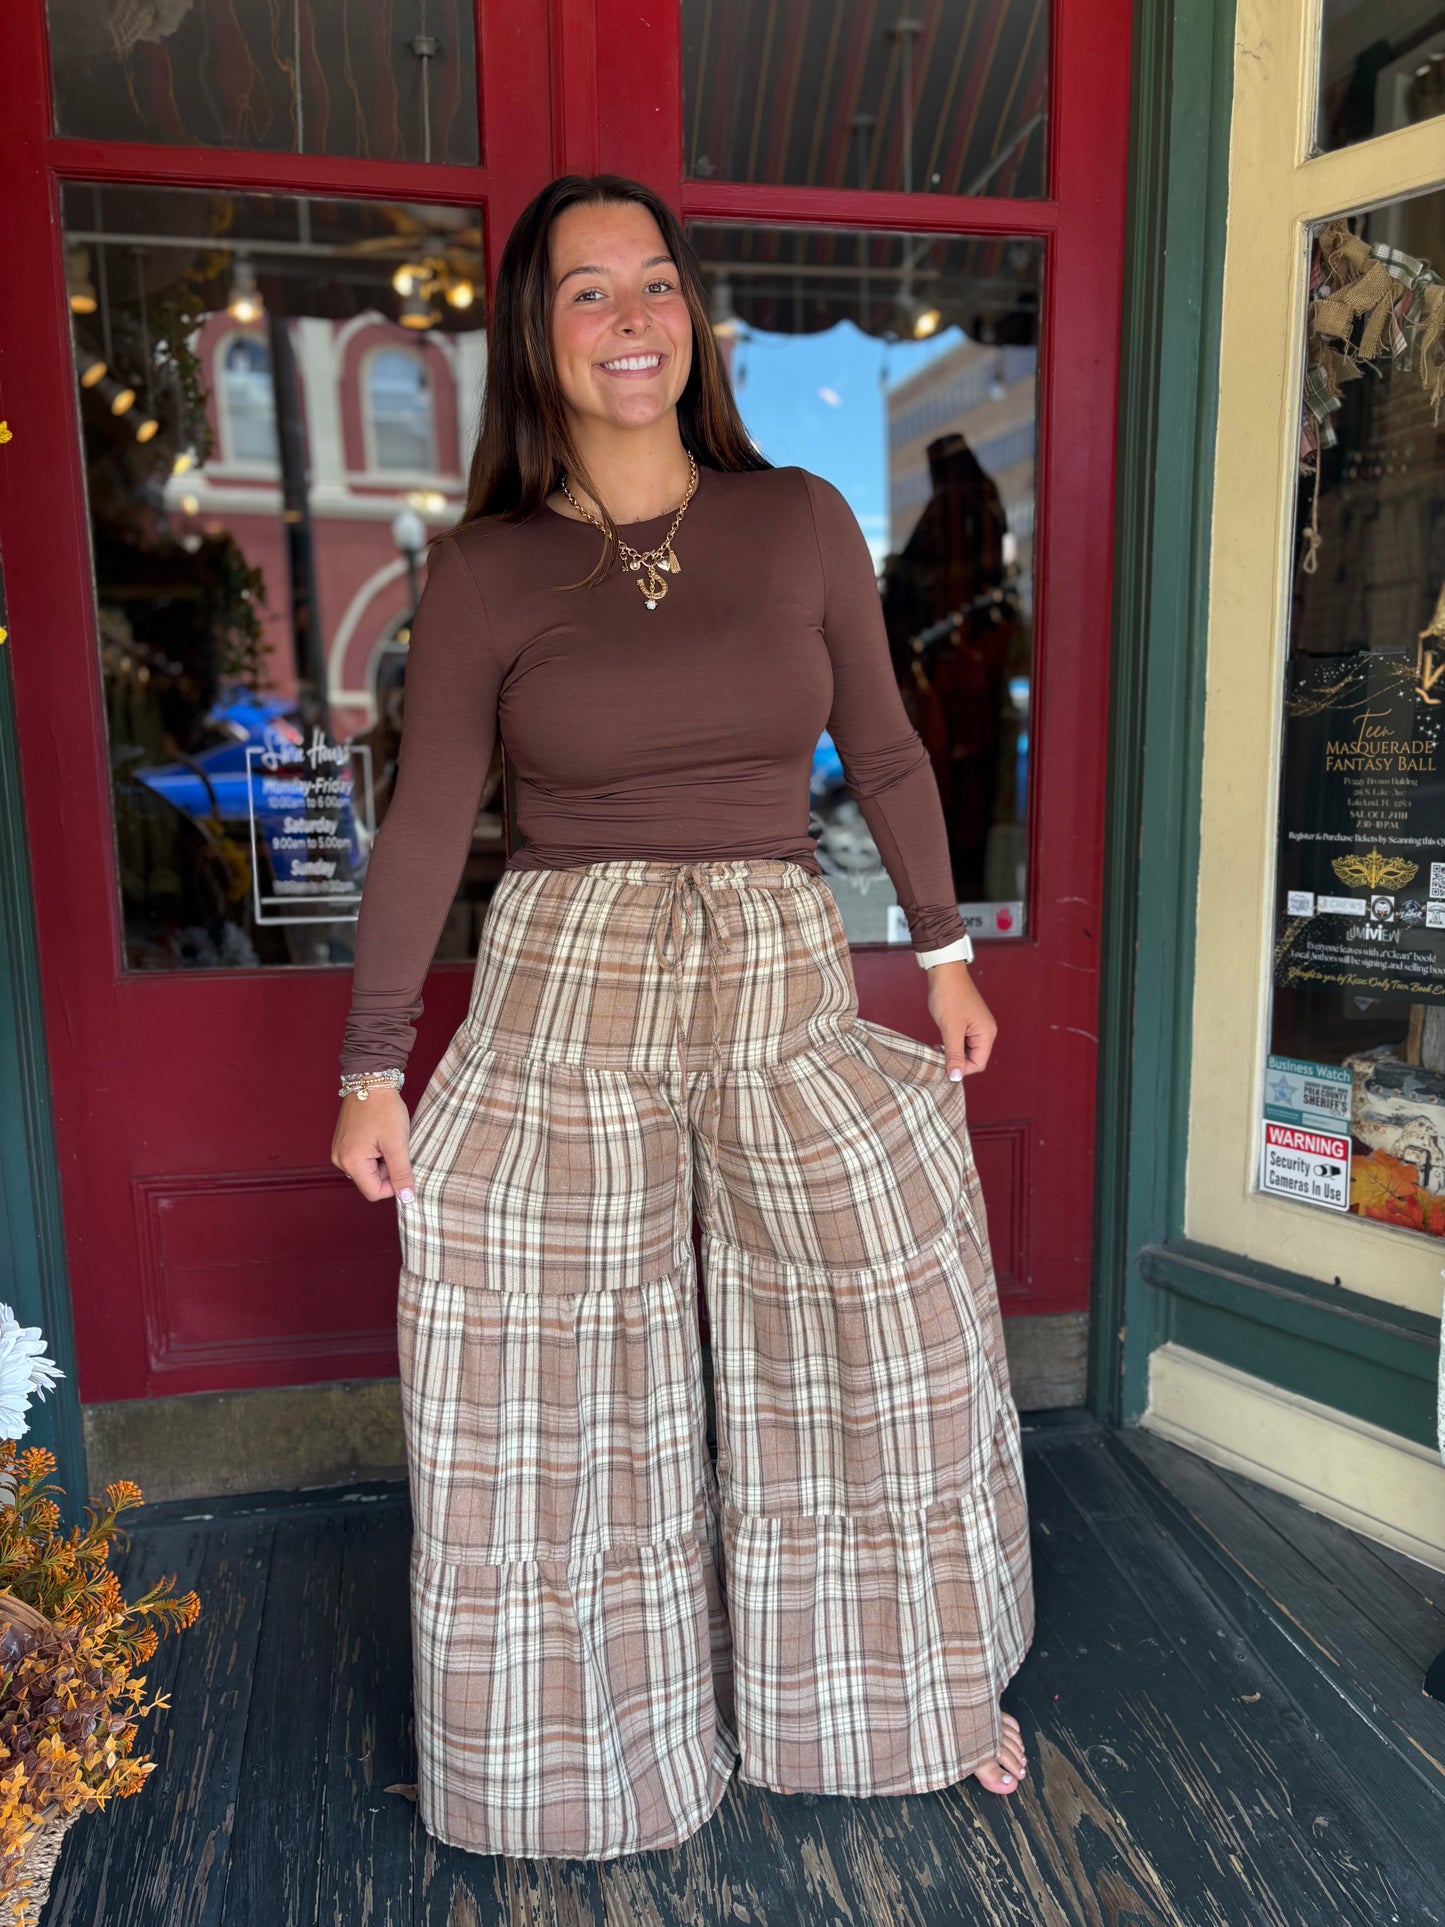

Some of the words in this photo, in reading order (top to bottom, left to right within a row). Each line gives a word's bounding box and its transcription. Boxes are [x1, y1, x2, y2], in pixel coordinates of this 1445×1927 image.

[1352, 708, 1395, 753] Teen
[1326, 740, 1434, 757] MASQUERADE
[1326, 756, 1393, 771] FANTASY
[1398, 756, 1437, 771] BALL
[306, 797, 316, 809] to
[283, 816, 339, 836] Saturday
[306, 838, 317, 849] to
[1288, 831, 1315, 842] Register
[1323, 832, 1353, 842] Purchase
[1354, 834, 1377, 843] Tickets
[1378, 834, 1386, 845] by
[1388, 835, 1421, 847] Scanning
[1422, 836, 1436, 845] this
[290, 858, 337, 878] Sunday
[1363, 947, 1378, 957] with
[1291, 950, 1310, 959] Local
[1351, 956, 1360, 966] be
[1361, 959, 1387, 970] signing
[1388, 961, 1403, 970] and
[1404, 963, 1429, 975] selling
[1269, 1057, 1313, 1075] Business
[1316, 1065, 1351, 1082] Watch
[1304, 1086, 1320, 1097] POLK
[1320, 1090, 1348, 1101] COUNTY
[1269, 1126, 1345, 1158] WARNING
[1270, 1151, 1310, 1177] Security
[1269, 1170, 1309, 1193] Cameras
[1312, 1180, 1321, 1196] In
[1324, 1183, 1341, 1201] Use
